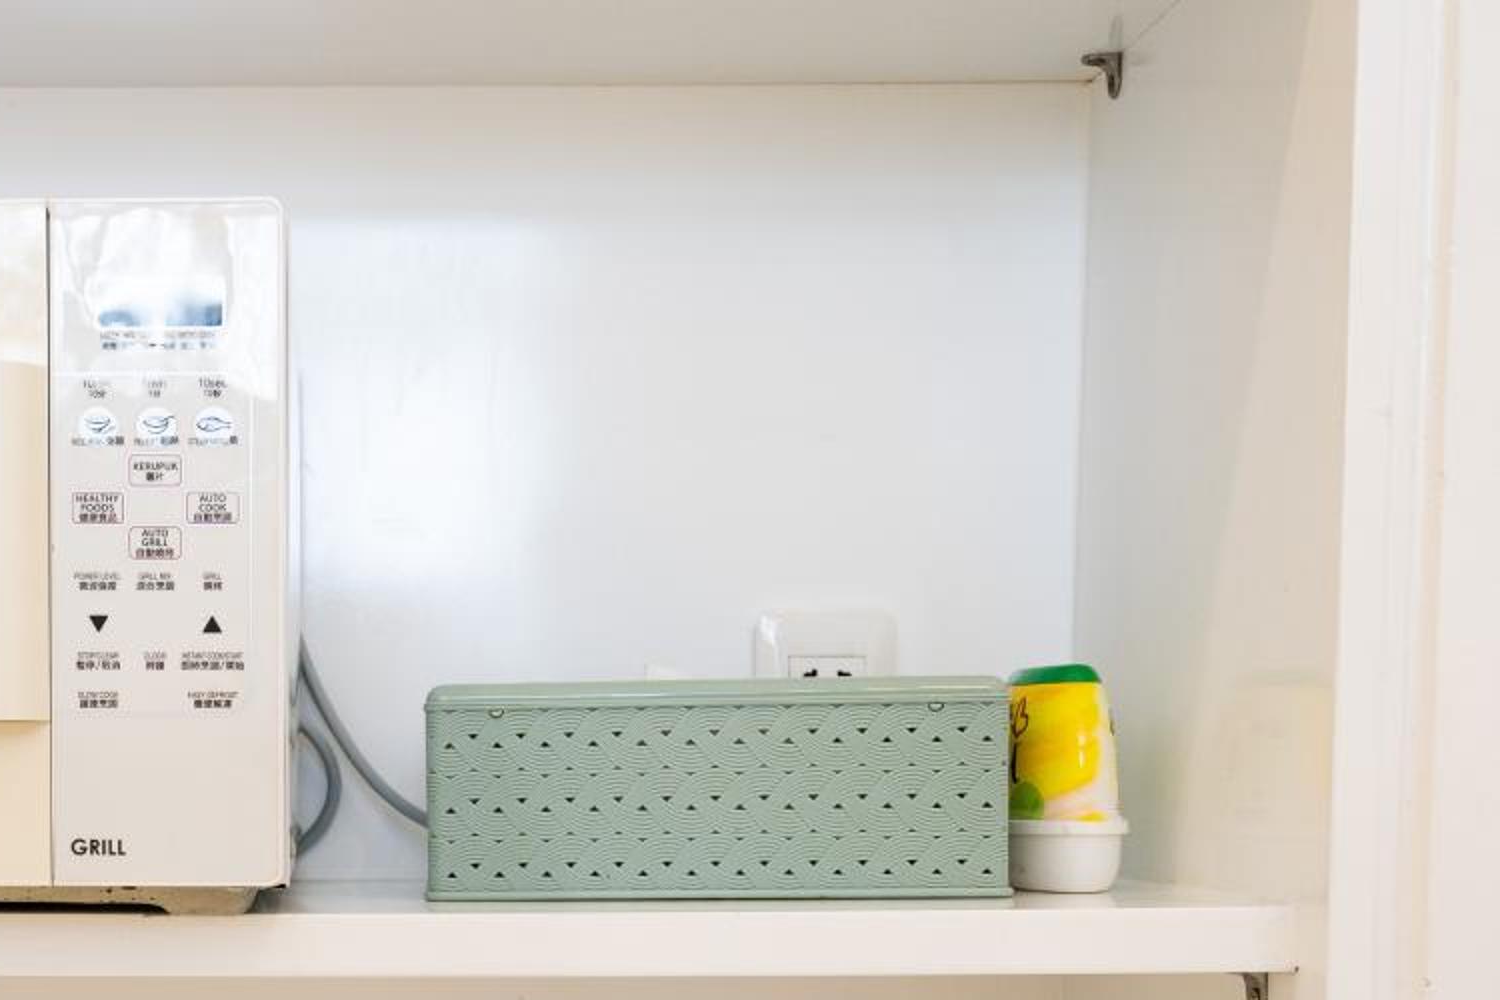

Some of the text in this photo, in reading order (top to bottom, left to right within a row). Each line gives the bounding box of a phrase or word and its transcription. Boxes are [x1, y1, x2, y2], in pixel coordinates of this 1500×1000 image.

[75, 493, 119, 503] HEALTHY
[199, 493, 227, 503] AUTO
[80, 503, 115, 513] FOODS
[199, 503, 227, 513] COOK
[141, 529, 169, 538] AUTO
[141, 537, 168, 547] GRILL
[71, 838, 127, 856] GRILL
